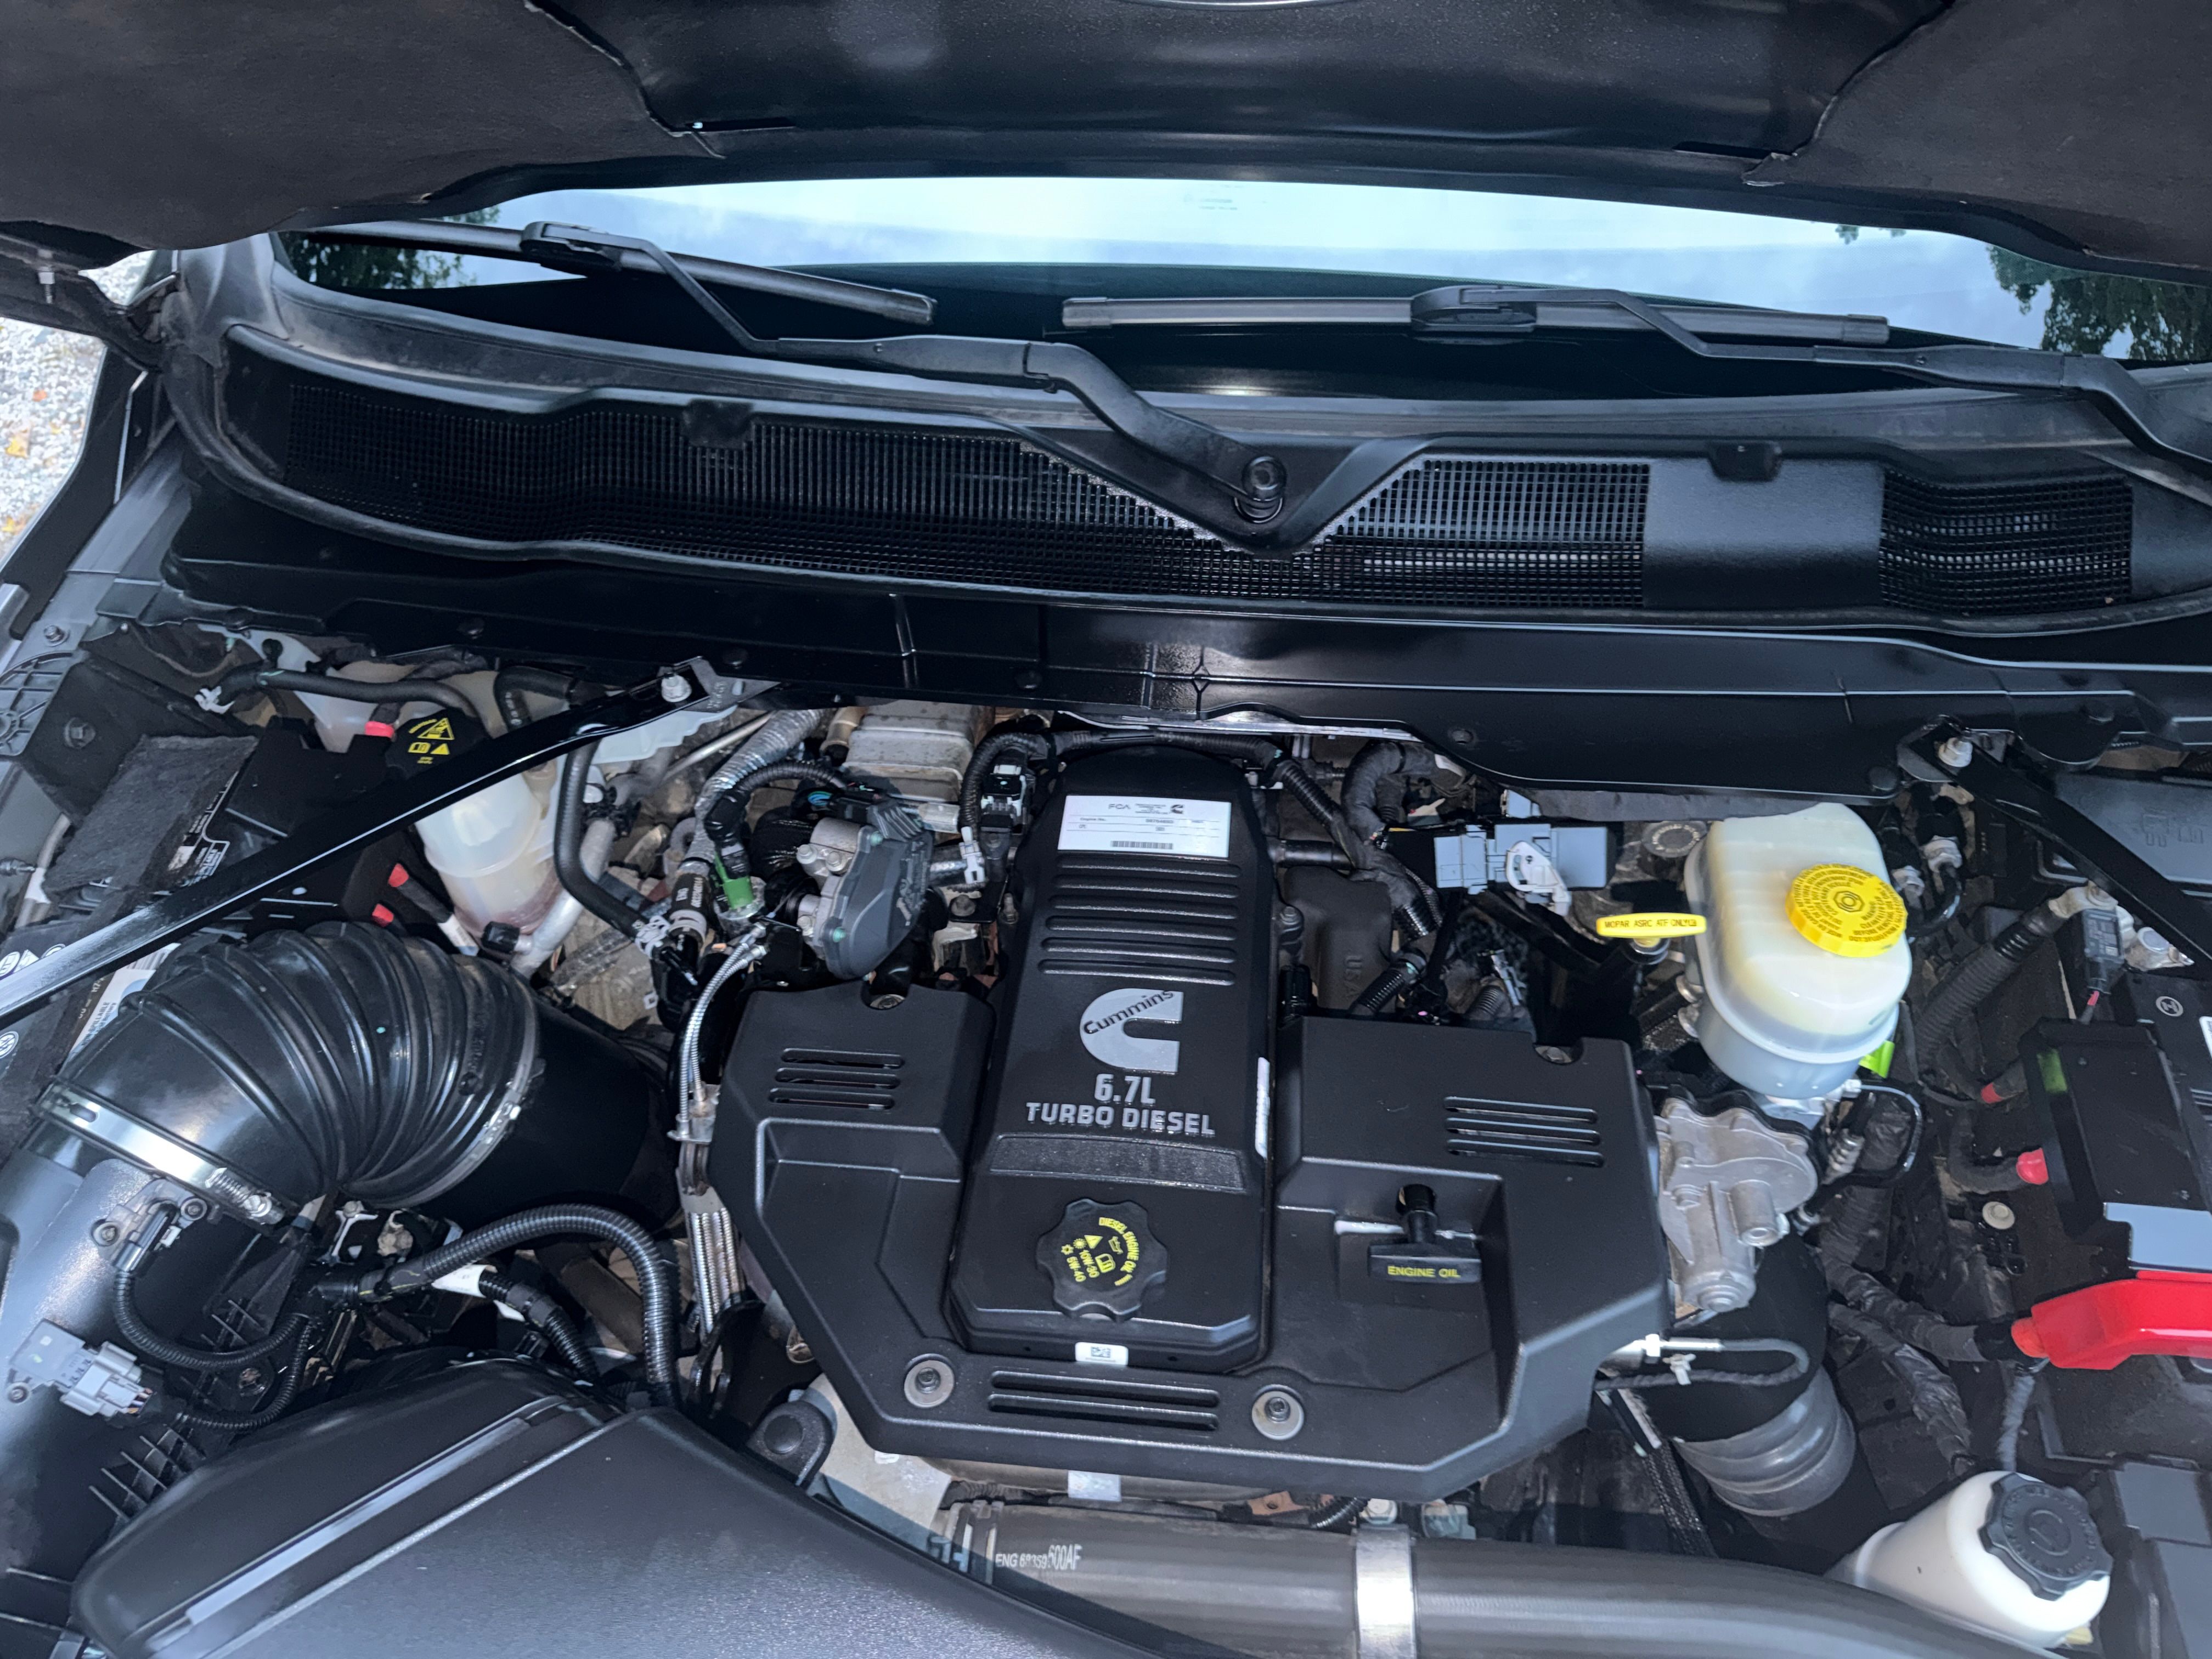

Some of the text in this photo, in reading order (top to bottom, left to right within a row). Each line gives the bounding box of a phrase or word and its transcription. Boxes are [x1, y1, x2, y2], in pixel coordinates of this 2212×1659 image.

[1083, 990, 1174, 1035] Cummins
[1094, 1074, 1156, 1105] 6.7L
[1026, 1102, 1215, 1137] TURBO DIESEL
[1099, 1217, 1127, 1234] DIESEL
[1122, 1231, 1139, 1261] ENGINE
[1066, 1256, 1086, 1282] 5W-40
[1079, 1250, 1099, 1278] 10W-30
[1120, 1261, 1137, 1273] OIL
[1387, 1265, 1461, 1279] ENGINE OIL
[995, 1553, 1018, 1567] ENG
